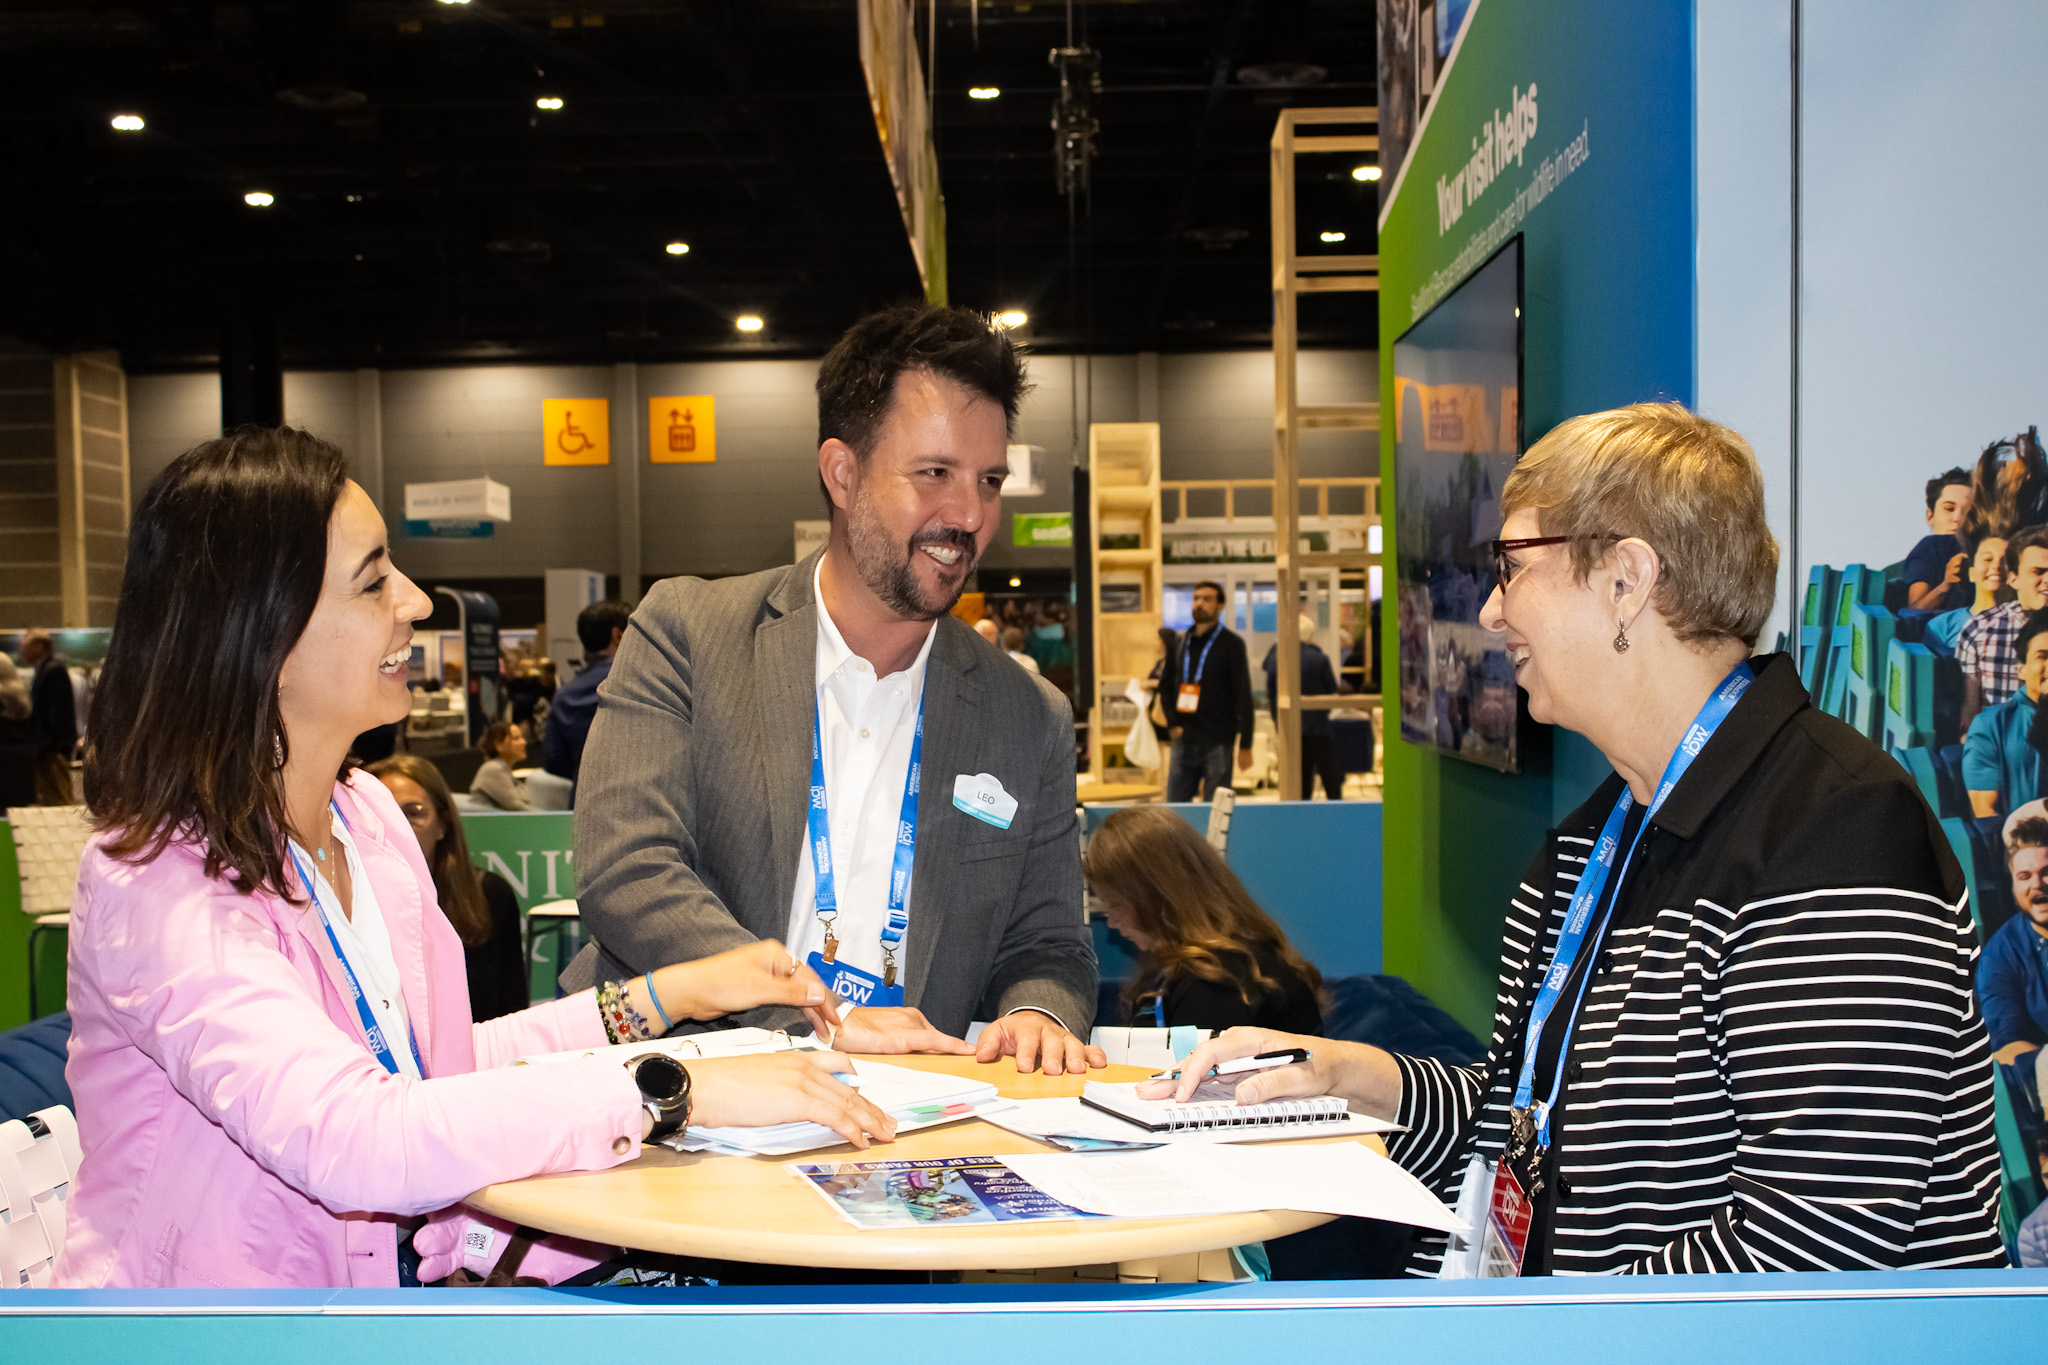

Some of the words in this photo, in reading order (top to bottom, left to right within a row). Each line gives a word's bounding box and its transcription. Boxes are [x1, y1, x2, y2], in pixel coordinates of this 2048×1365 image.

[1437, 173, 1466, 237] Your
[1466, 121, 1495, 206] visit
[1495, 82, 1538, 176] helps
[1719, 675, 1744, 700] AMERICAN
[1728, 678, 1750, 699] EXPRESS
[908, 762, 918, 797] AMERICAN
[977, 790, 995, 805] LEO
[820, 836, 830, 873] AMERICAN
[1573, 893, 1595, 935] AMERICAN
[337, 957, 361, 999] AMERICAN
[864, 1162, 912, 1170] PARKS
[914, 1160, 943, 1168] OUR
